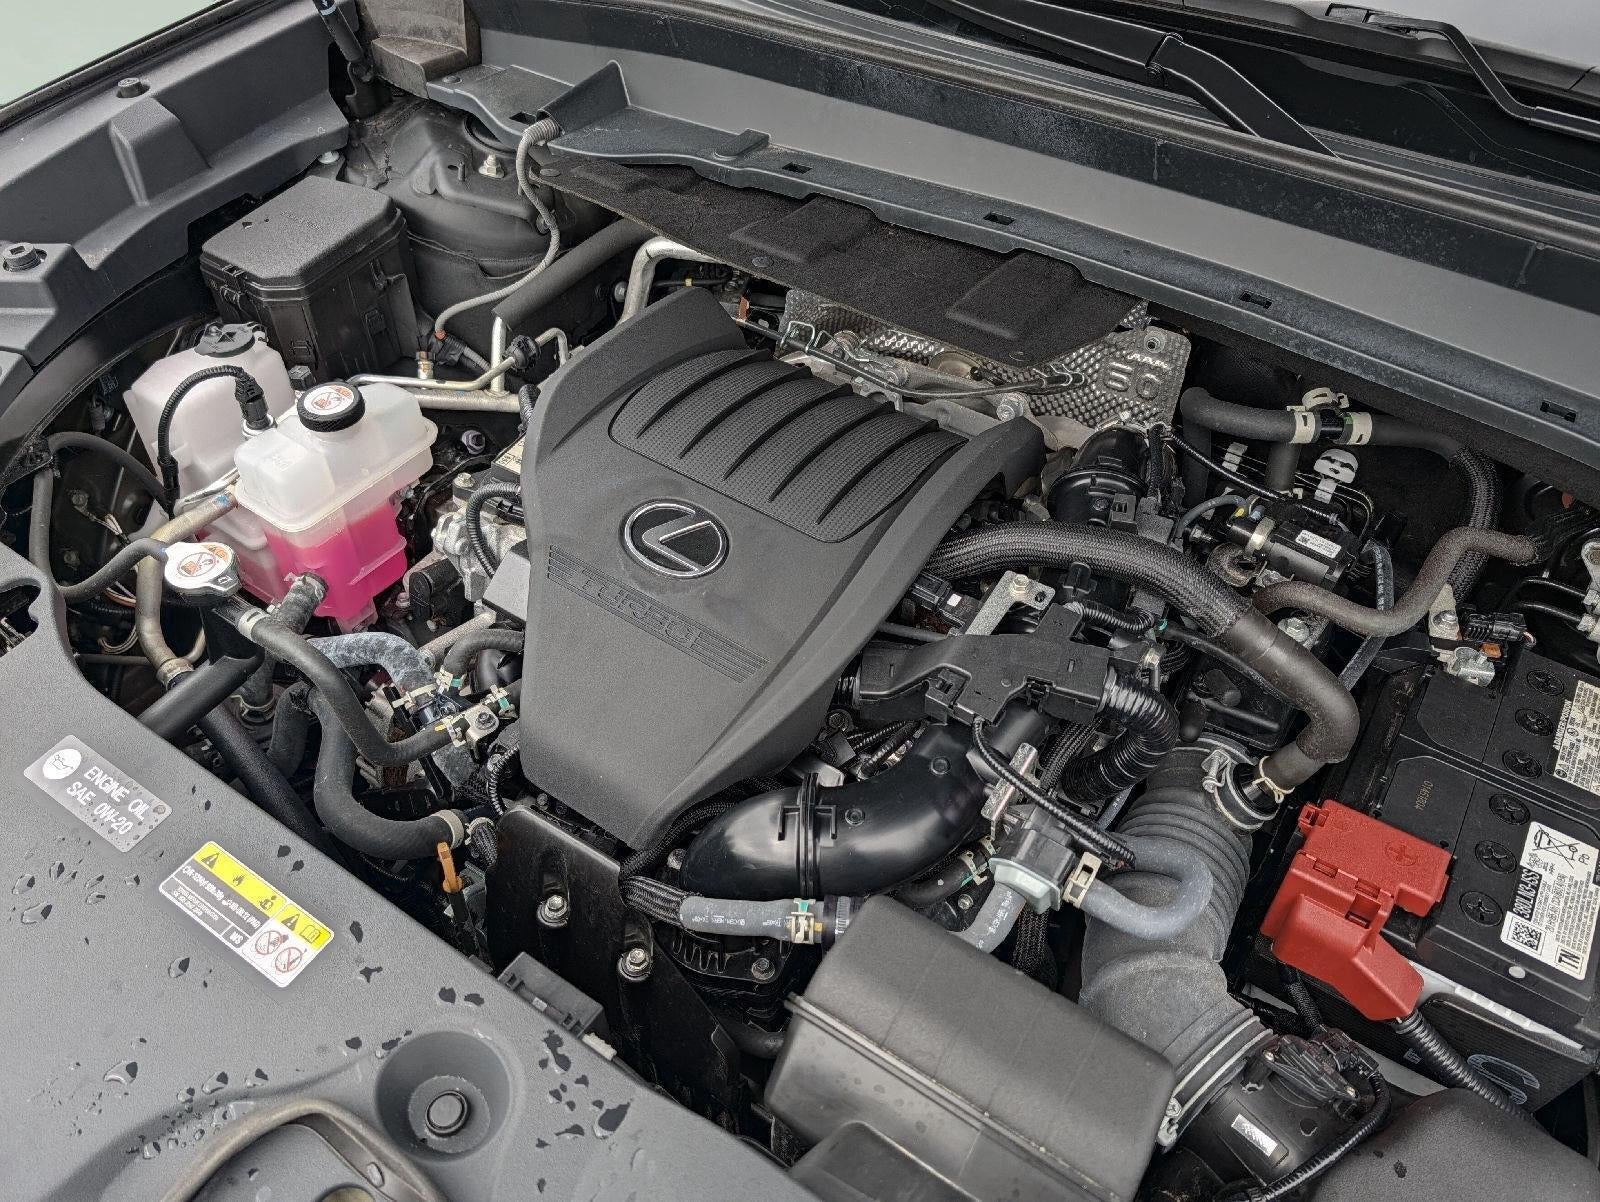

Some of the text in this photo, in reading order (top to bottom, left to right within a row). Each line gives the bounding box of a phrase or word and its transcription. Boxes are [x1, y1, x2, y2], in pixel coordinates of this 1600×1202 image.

[581, 567, 697, 644] TURBO
[66, 781, 133, 834] SAE 0W-20
[83, 766, 150, 820] ENGINE OIL
[1557, 948, 1581, 969] TN
